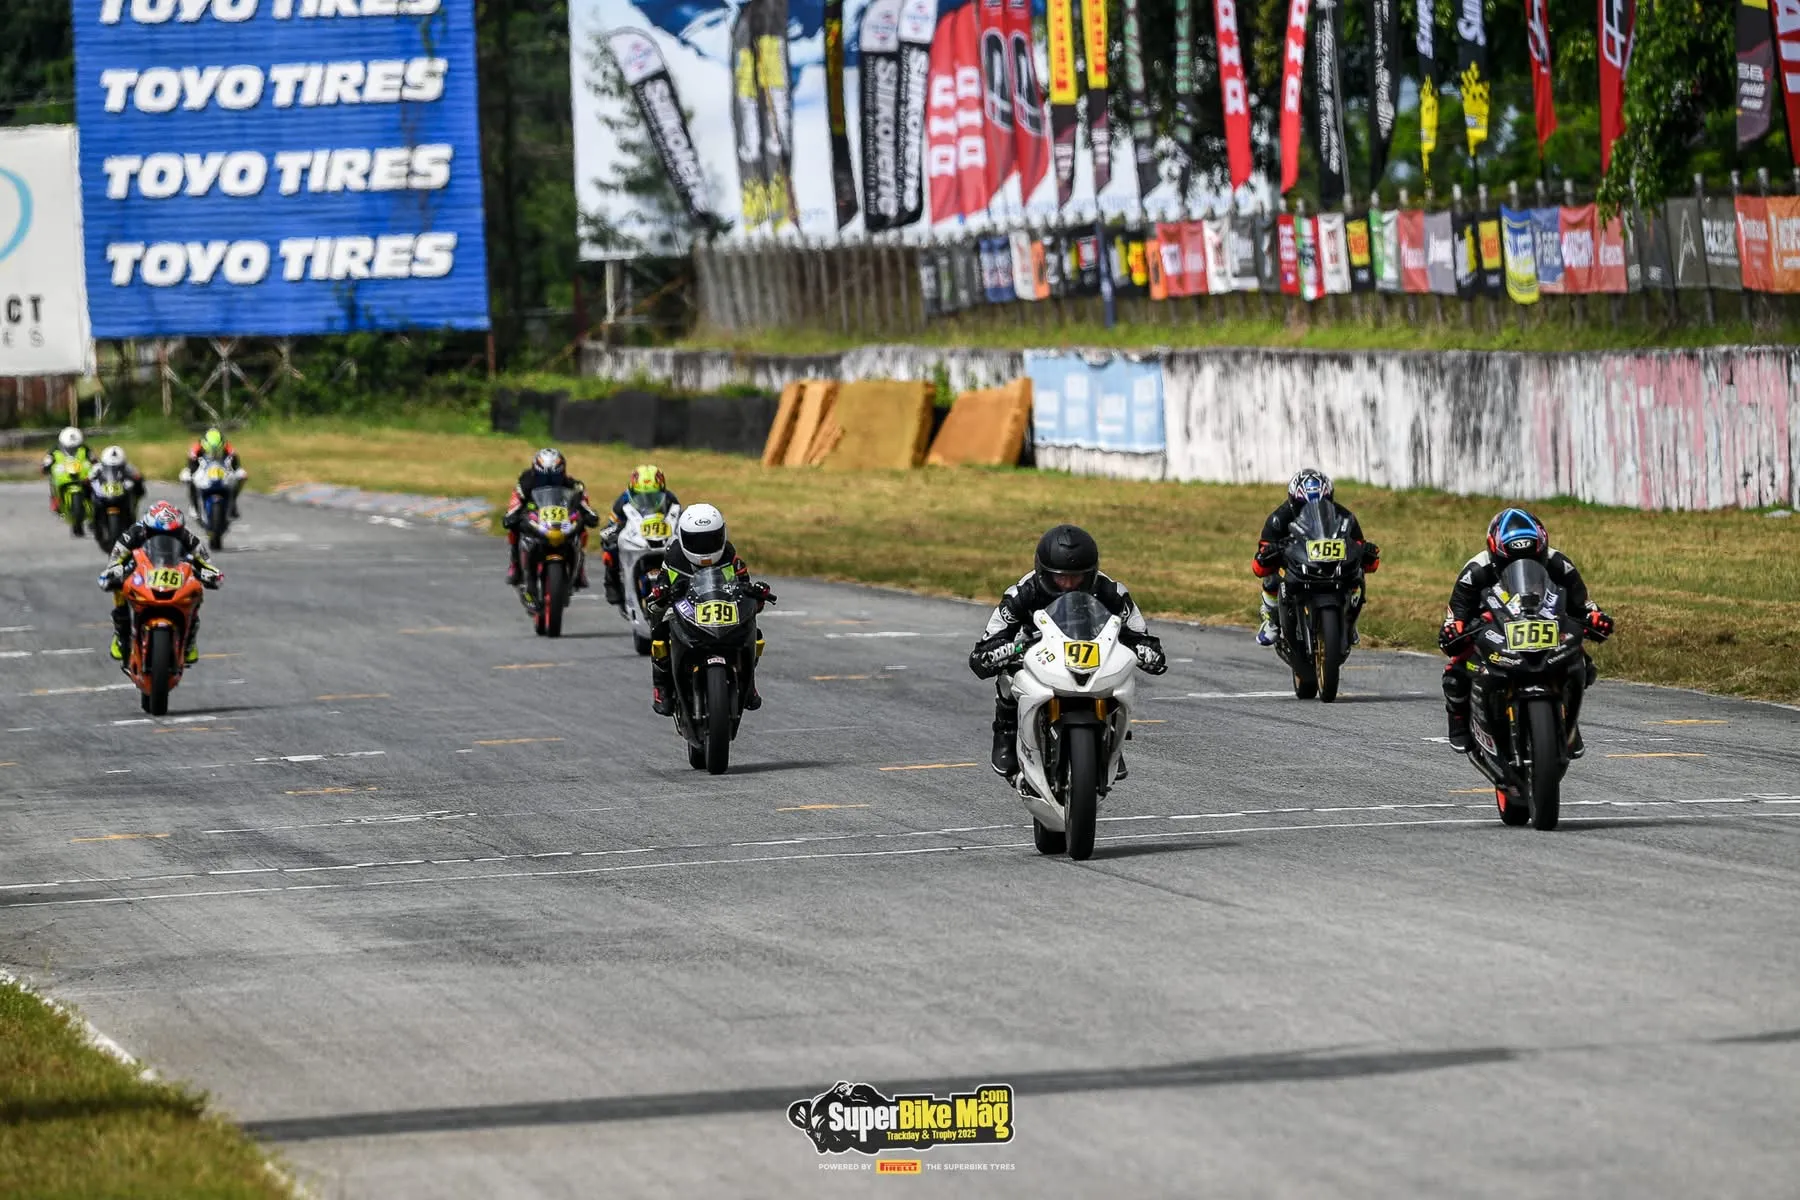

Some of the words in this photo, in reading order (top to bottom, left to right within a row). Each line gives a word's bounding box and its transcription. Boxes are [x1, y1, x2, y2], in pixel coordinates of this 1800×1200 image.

[101, 65, 264, 113] TOYO
[270, 57, 448, 108] TIRES
[103, 152, 268, 199] TOYO
[274, 144, 453, 195] TIRES
[106, 239, 271, 287] TOYO
[280, 232, 458, 281] TIRES
[1310, 541, 1341, 558] 465
[151, 570, 179, 586] 146
[701, 603, 733, 623] 539
[1512, 622, 1554, 647] 665
[1067, 642, 1094, 664] 97
